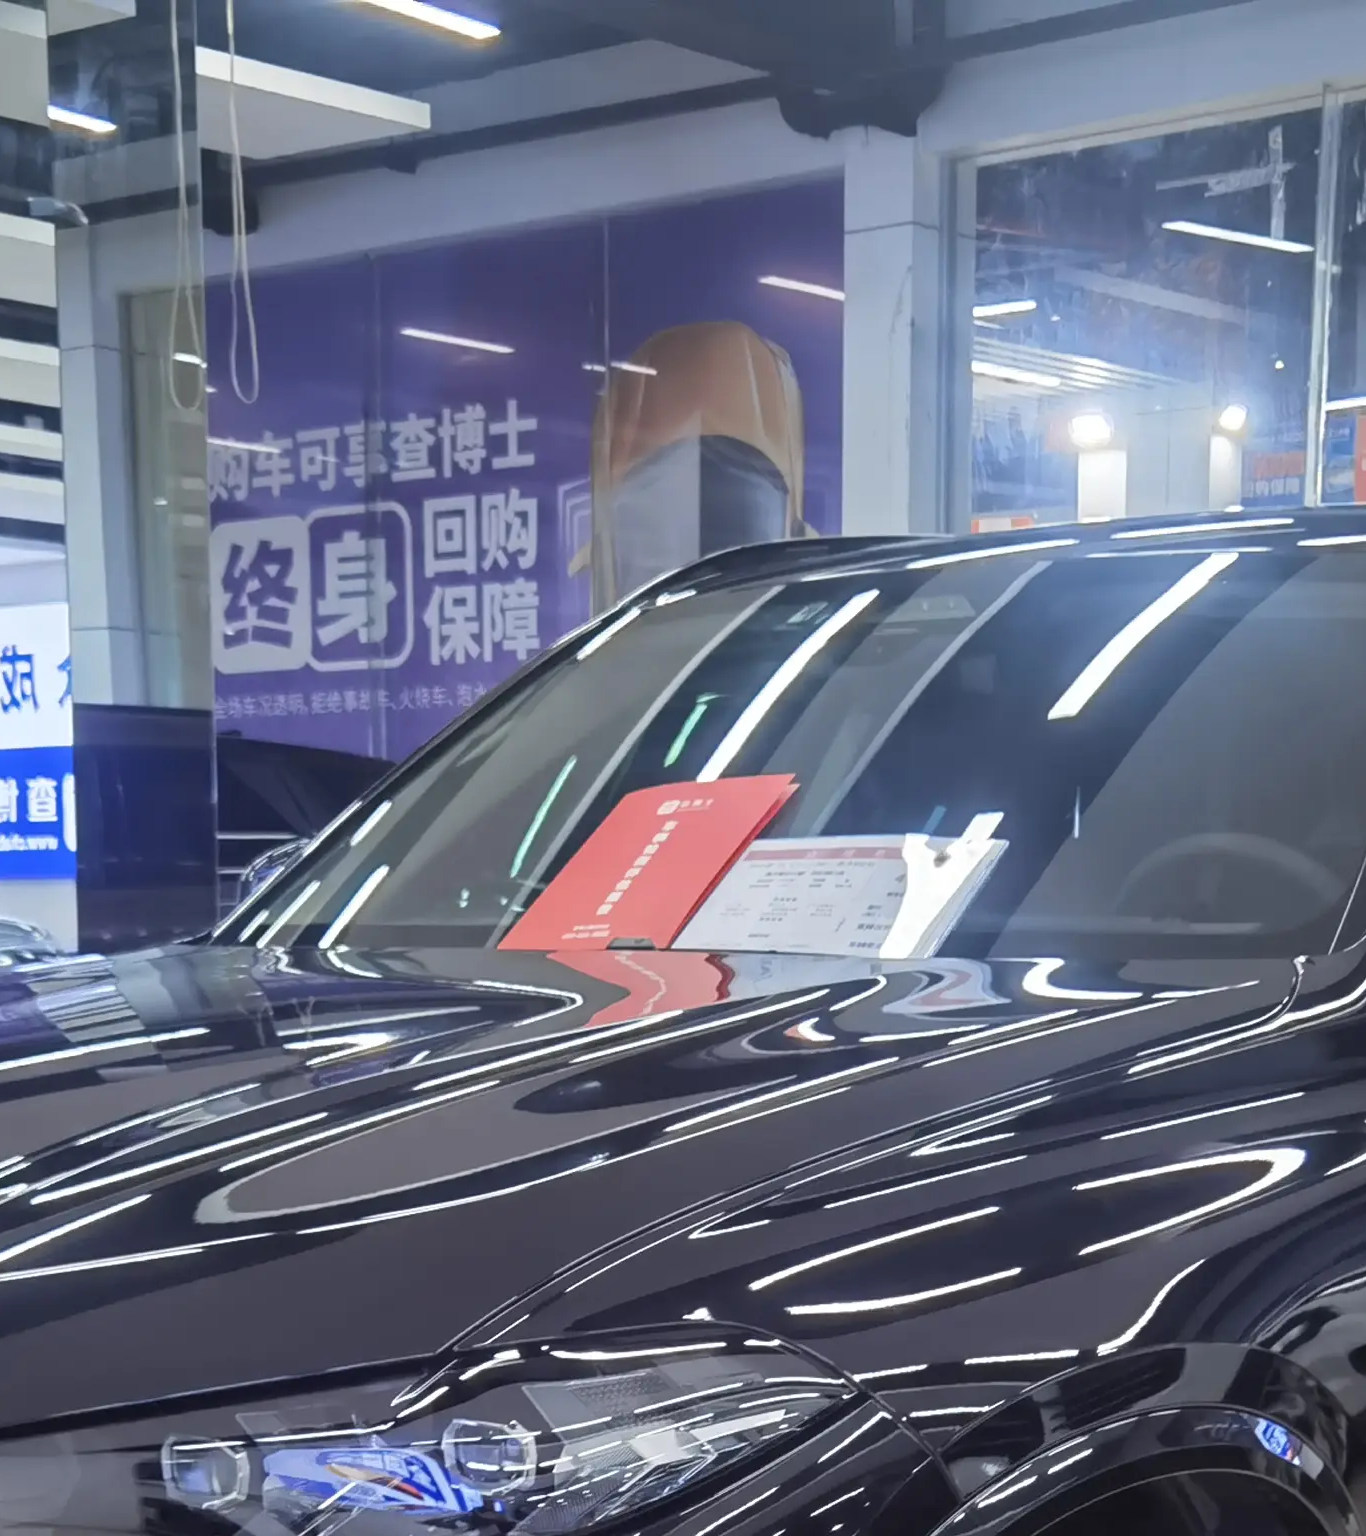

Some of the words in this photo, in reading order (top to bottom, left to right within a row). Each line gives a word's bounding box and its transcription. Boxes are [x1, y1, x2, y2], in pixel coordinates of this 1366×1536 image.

[208, 399, 539, 503] 购车可享查博士
[423, 488, 539, 579] 回购
[221, 531, 398, 650] 终身
[423, 577, 541, 667] 保障
